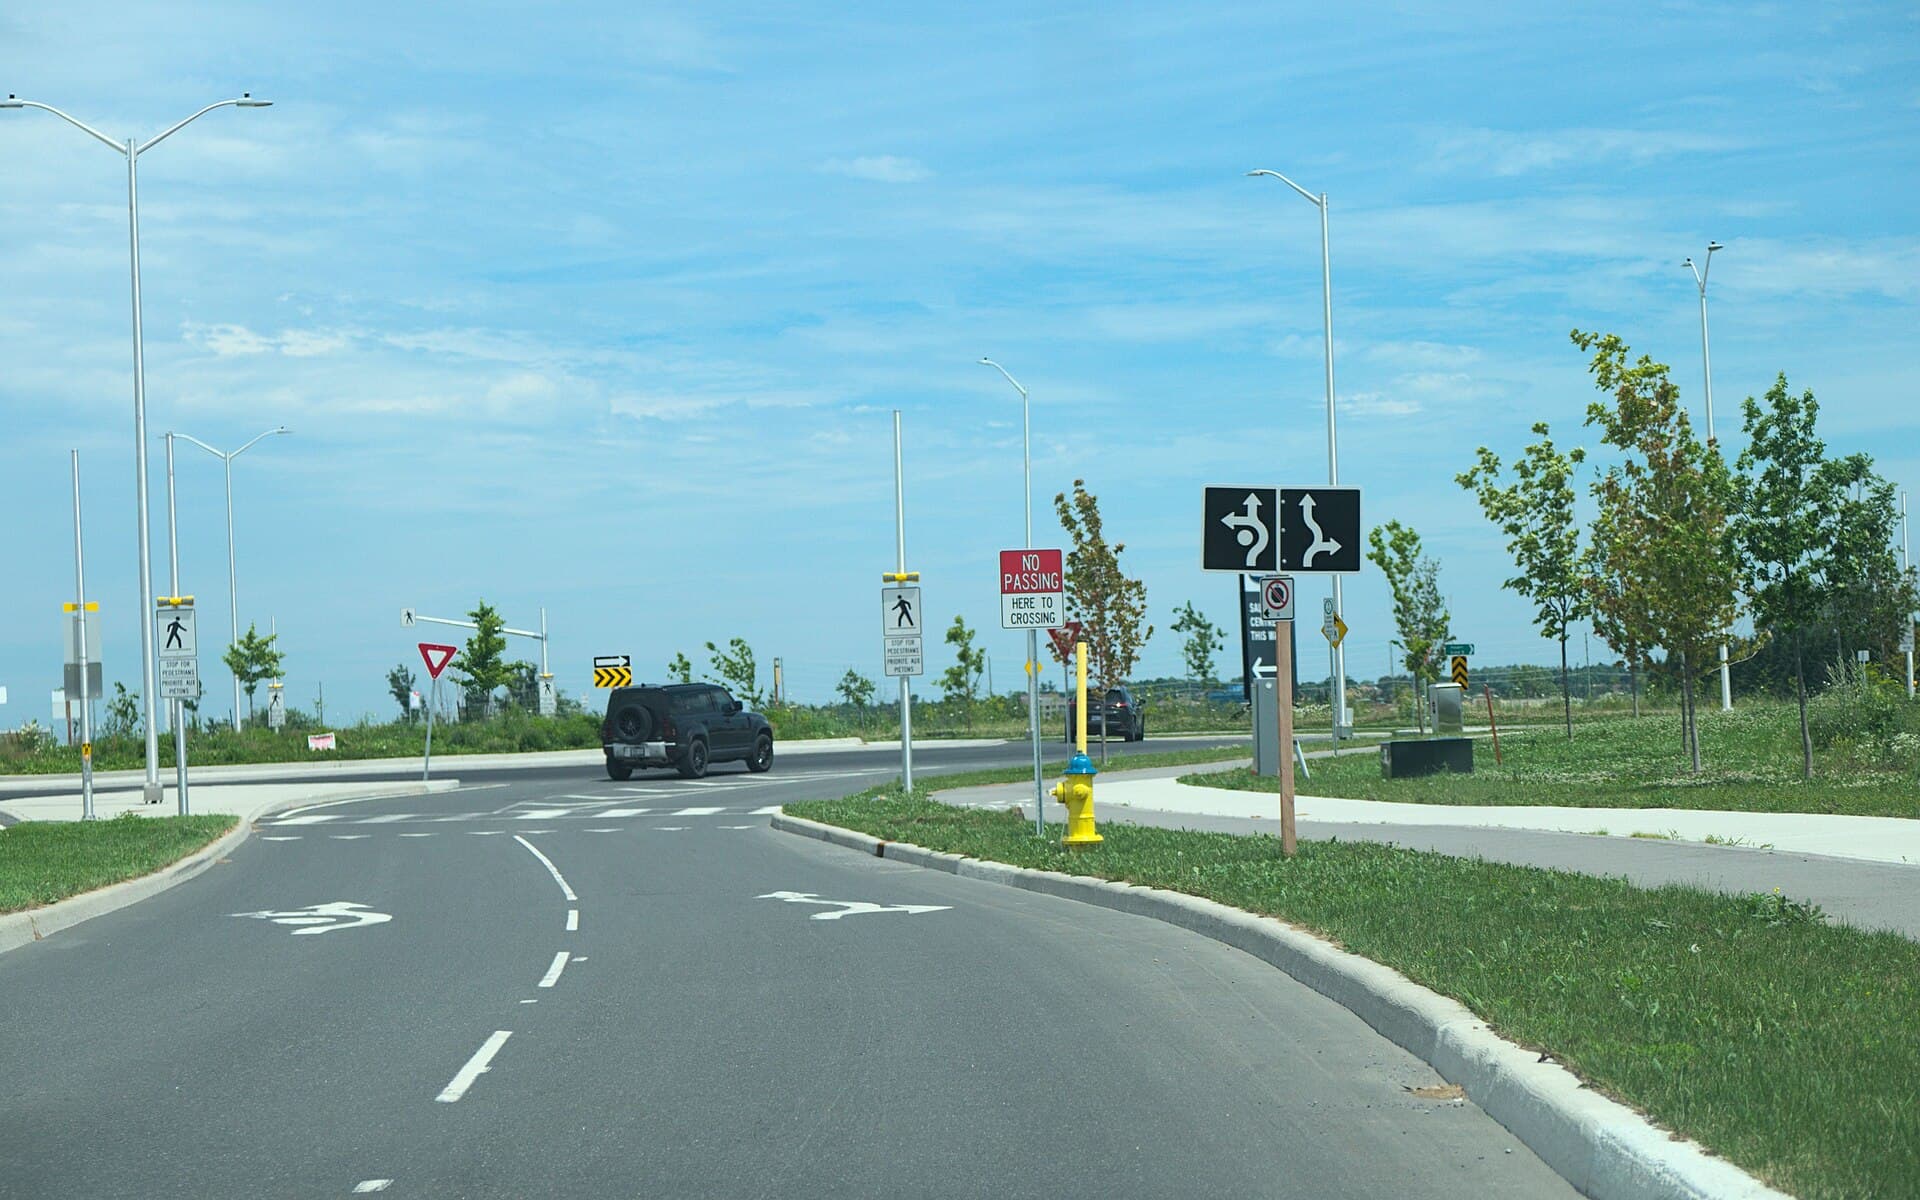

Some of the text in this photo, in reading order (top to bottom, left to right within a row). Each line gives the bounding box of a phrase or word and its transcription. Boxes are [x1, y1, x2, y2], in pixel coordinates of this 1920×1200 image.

[1022, 554, 1040, 571] NO
[1004, 572, 1059, 591] PASSING
[1012, 596, 1053, 609] HERE TO
[1010, 611, 1056, 625] CROSSING
[1250, 630, 1267, 641] THIS
[887, 647, 919, 655] PEDESTRIANS
